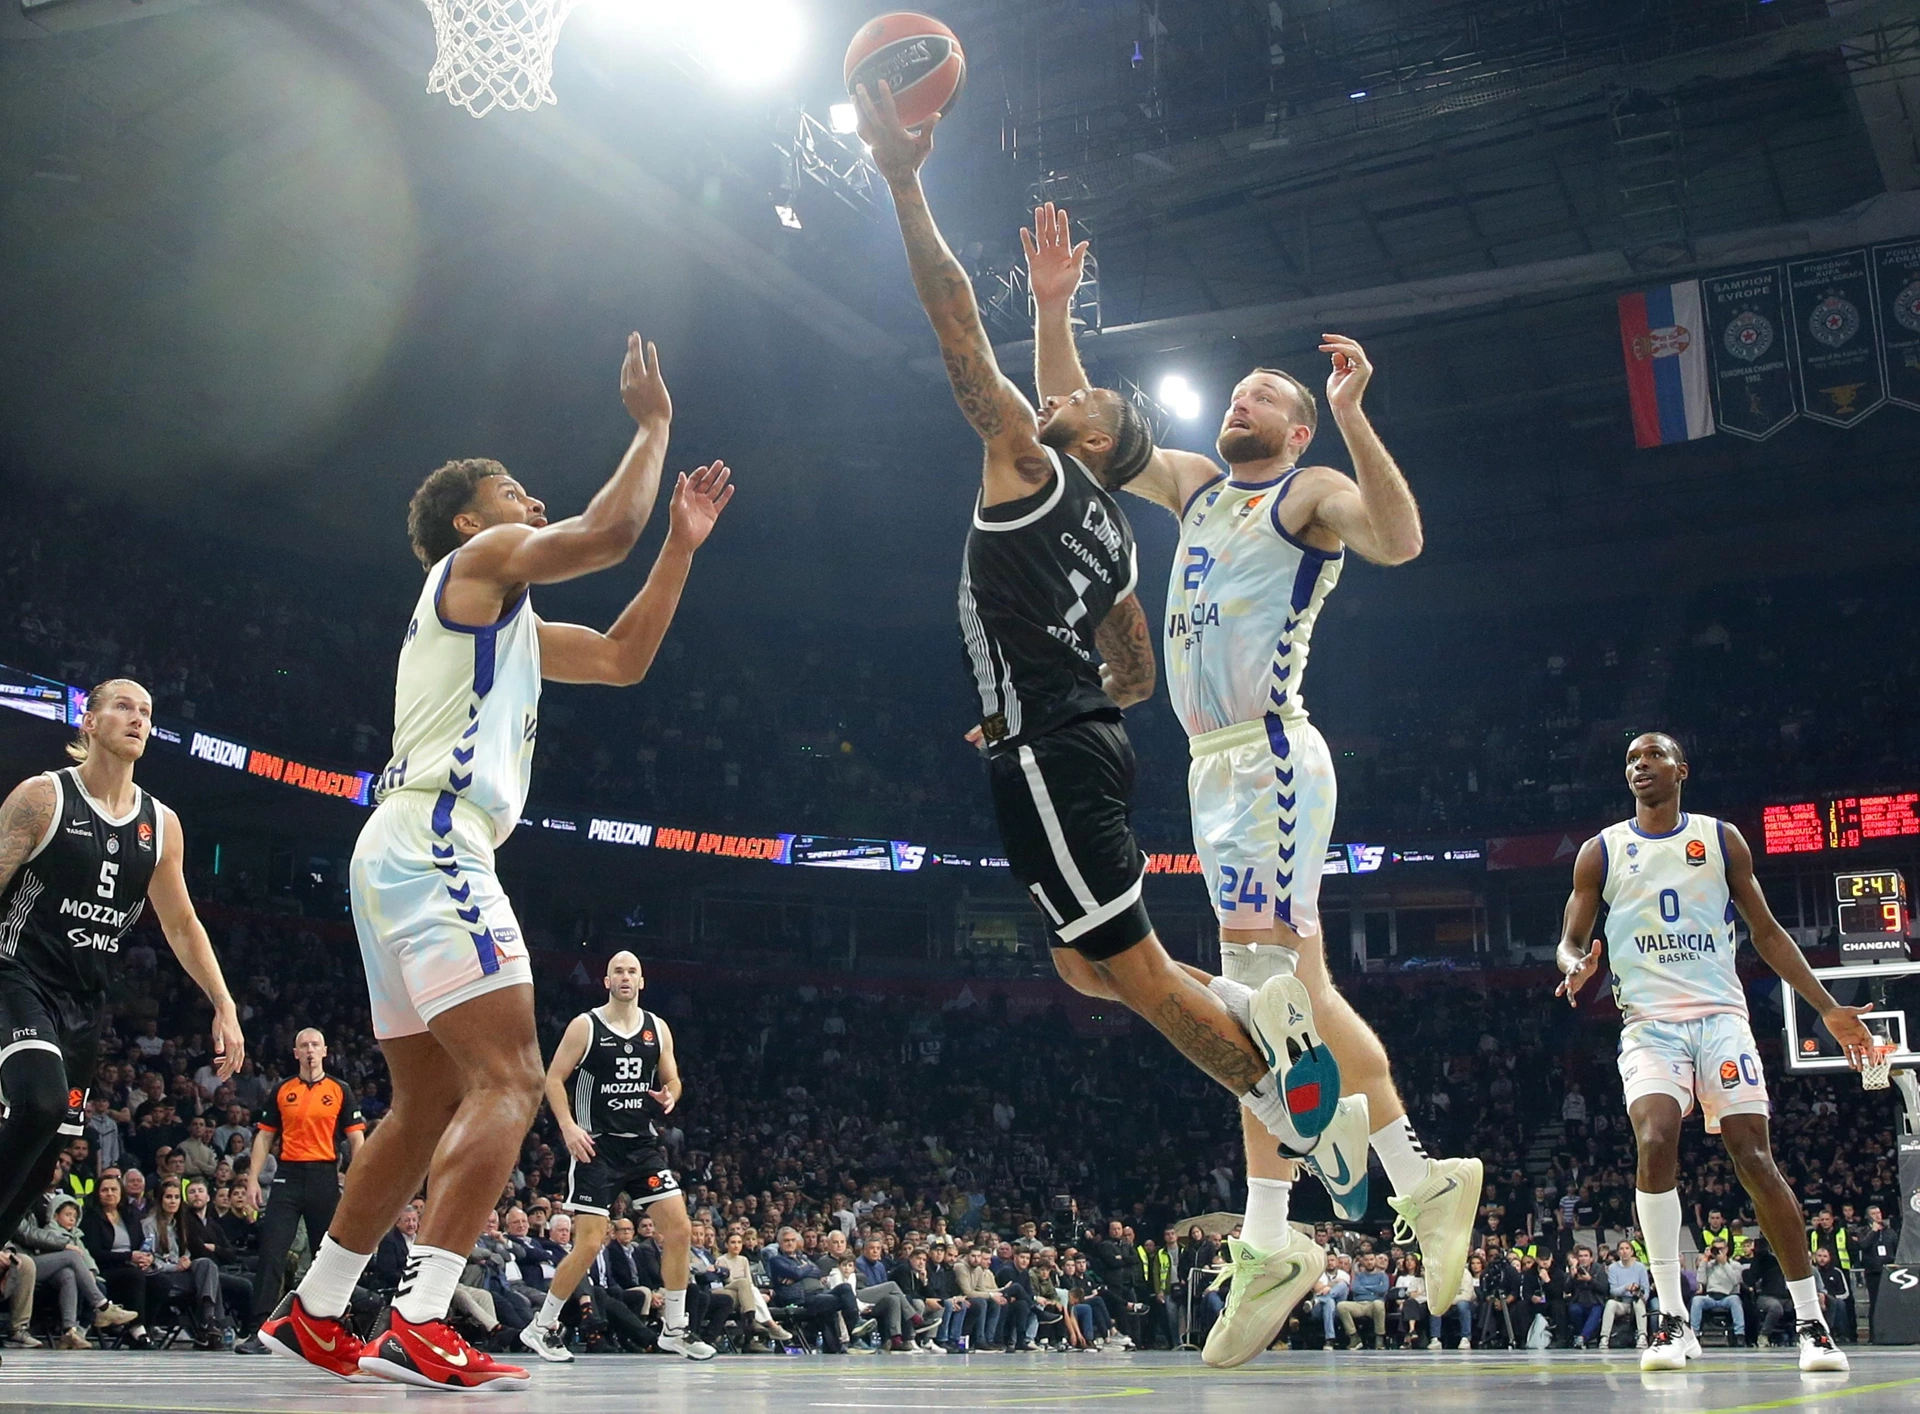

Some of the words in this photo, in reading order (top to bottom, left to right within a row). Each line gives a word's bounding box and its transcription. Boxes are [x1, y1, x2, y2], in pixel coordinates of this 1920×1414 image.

[1717, 286, 1770, 302] EVROPE
[190, 732, 248, 770] PREUZMI
[248, 750, 285, 781] NOVU
[588, 818, 653, 847] PREUZMI
[654, 826, 696, 852] NOVU
[1144, 853, 1202, 875] APLIKA
[97, 860, 120, 899] 5
[1219, 864, 1268, 913] 24
[1852, 876, 1897, 896] 2:41
[60, 898, 127, 928] MOZZAR
[1029, 882, 1065, 925] 1
[1660, 888, 1680, 922] 0
[1882, 904, 1900, 931] 9
[92, 932, 120, 953] NIS
[1634, 933, 1716, 954] VALENCIA
[1842, 940, 1900, 951] CHANGAN
[12, 1026, 38, 1040] mts
[614, 1057, 643, 1080] 33
[1739, 1053, 1759, 1086] 0
[624, 1098, 643, 1109] NIS
